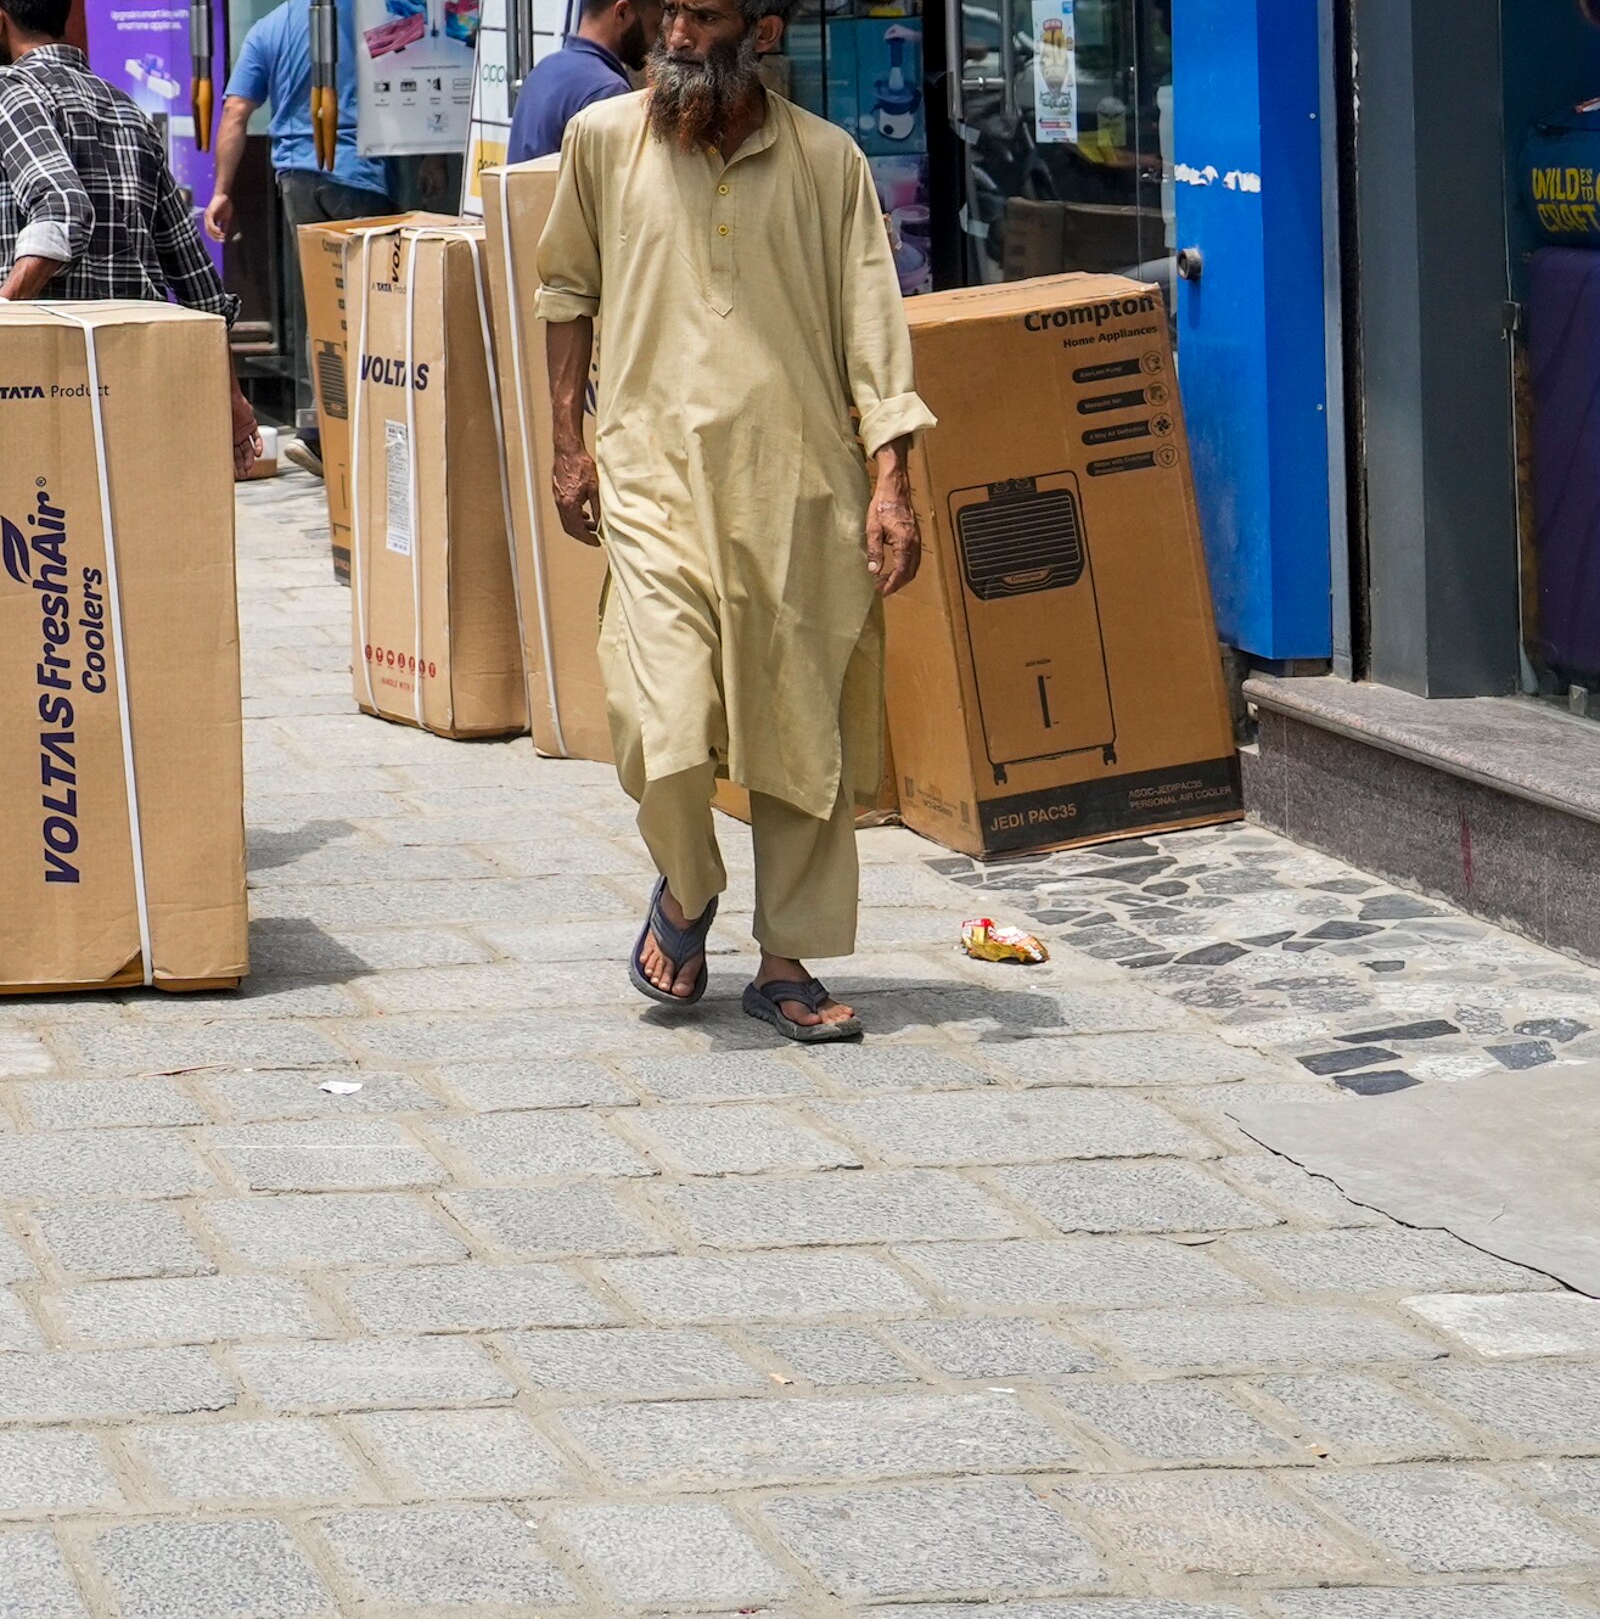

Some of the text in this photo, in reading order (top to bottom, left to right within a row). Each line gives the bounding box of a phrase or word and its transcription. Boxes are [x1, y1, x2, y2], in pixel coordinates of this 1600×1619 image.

[482, 64, 505, 83] opp
[1532, 166, 1581, 202] WILD
[377, 282, 393, 294] TATA
[1023, 294, 1155, 334] Crompton
[1062, 323, 1159, 350] Home Appliances
[360, 353, 430, 391] VOLTAS
[49, 382, 111, 400] Product
[81, 566, 106, 694] Coolers
[1130, 784, 1232, 810] PERSONAL AIR COOLER
[990, 802, 1078, 833] JEDI PAC35
